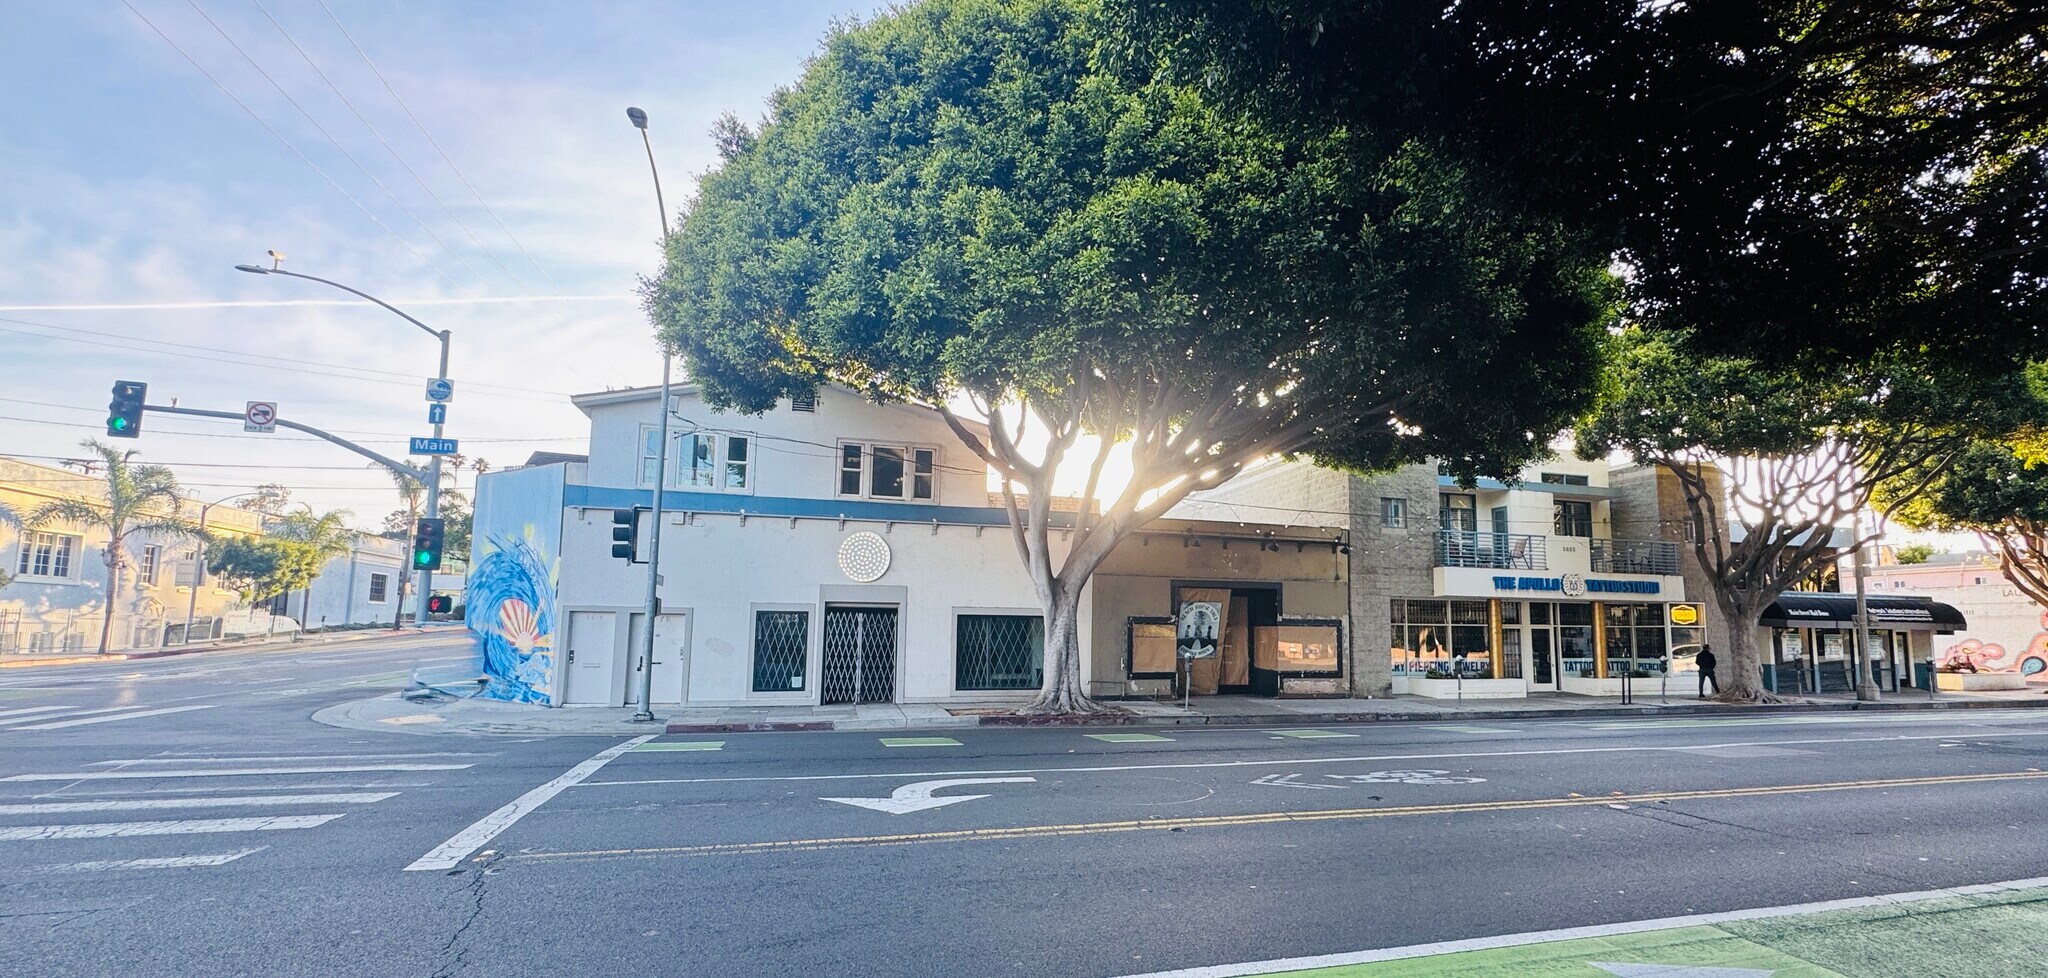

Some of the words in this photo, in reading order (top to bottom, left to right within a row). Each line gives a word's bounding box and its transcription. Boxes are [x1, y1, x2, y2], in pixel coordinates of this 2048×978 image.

[415, 439, 453, 451] Main
[1493, 576, 1516, 590] THE
[1518, 577, 1561, 591] APOLLO
[1392, 663, 1405, 672] RY
[1409, 661, 1449, 672] PIERCING
[1606, 660, 1630, 672] ATTOO
[1638, 662, 1661, 671] PIERCI
